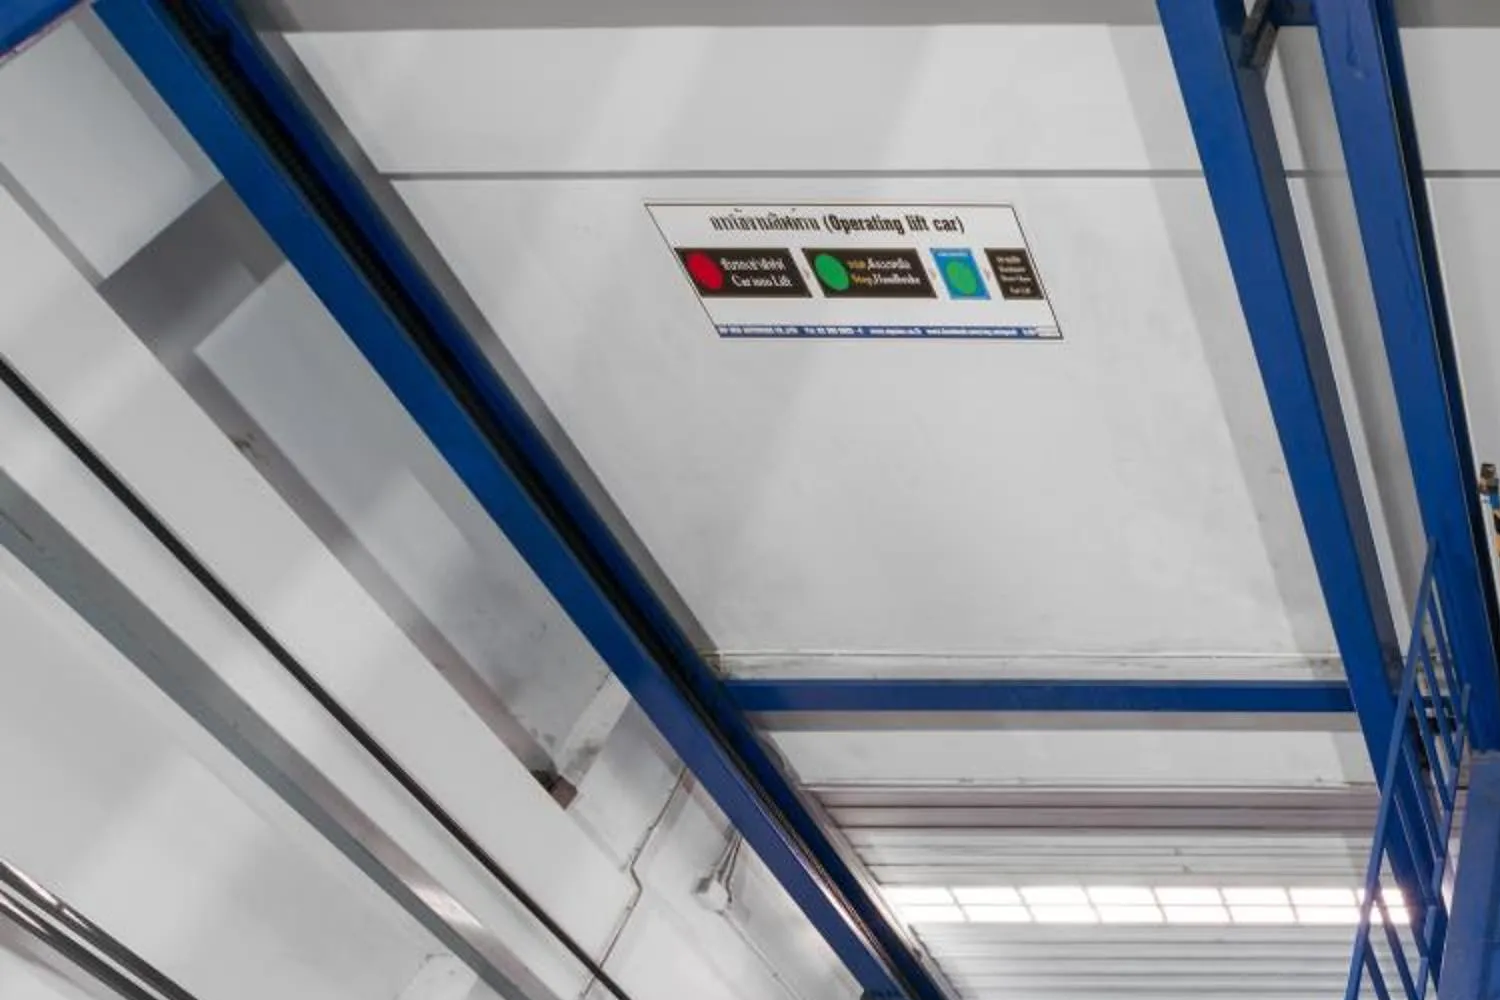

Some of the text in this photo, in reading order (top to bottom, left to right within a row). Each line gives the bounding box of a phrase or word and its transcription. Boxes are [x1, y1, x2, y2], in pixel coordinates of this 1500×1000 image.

[823, 213, 905, 235] (Operating
[906, 214, 929, 231] lift
[932, 214, 965, 233] car)
[732, 275, 752, 288] Car
[773, 275, 792, 288] Lift
